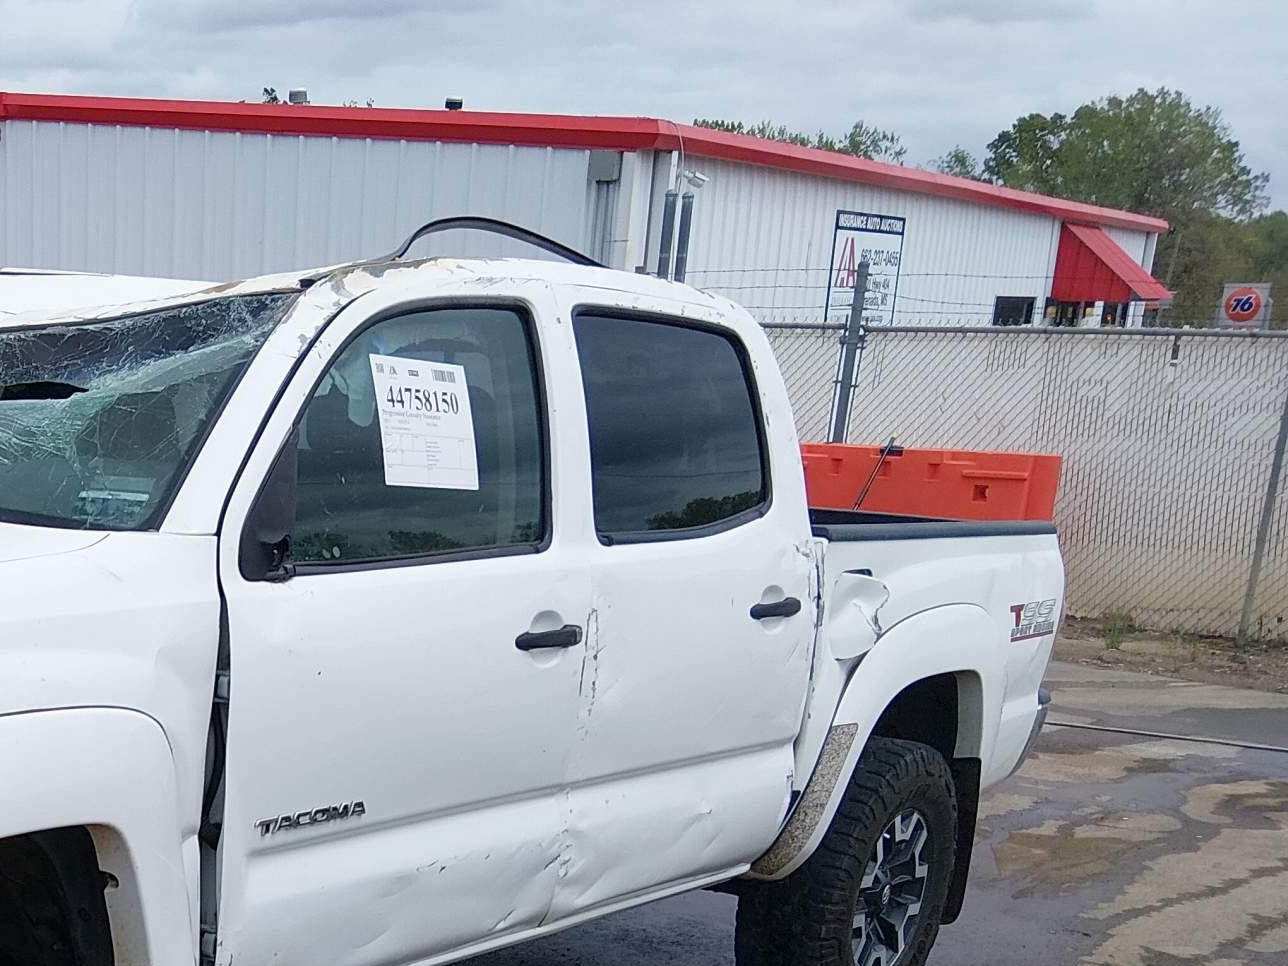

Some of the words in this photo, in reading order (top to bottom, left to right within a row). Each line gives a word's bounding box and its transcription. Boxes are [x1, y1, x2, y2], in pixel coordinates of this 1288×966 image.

[839, 213, 867, 229] INSURANCE
[867, 216, 881, 231] AUTO
[880, 218, 904, 233] AUCTIONS
[1229, 294, 1256, 313] 76
[386, 385, 459, 415] 44758150
[254, 800, 366, 836] TACOMA
